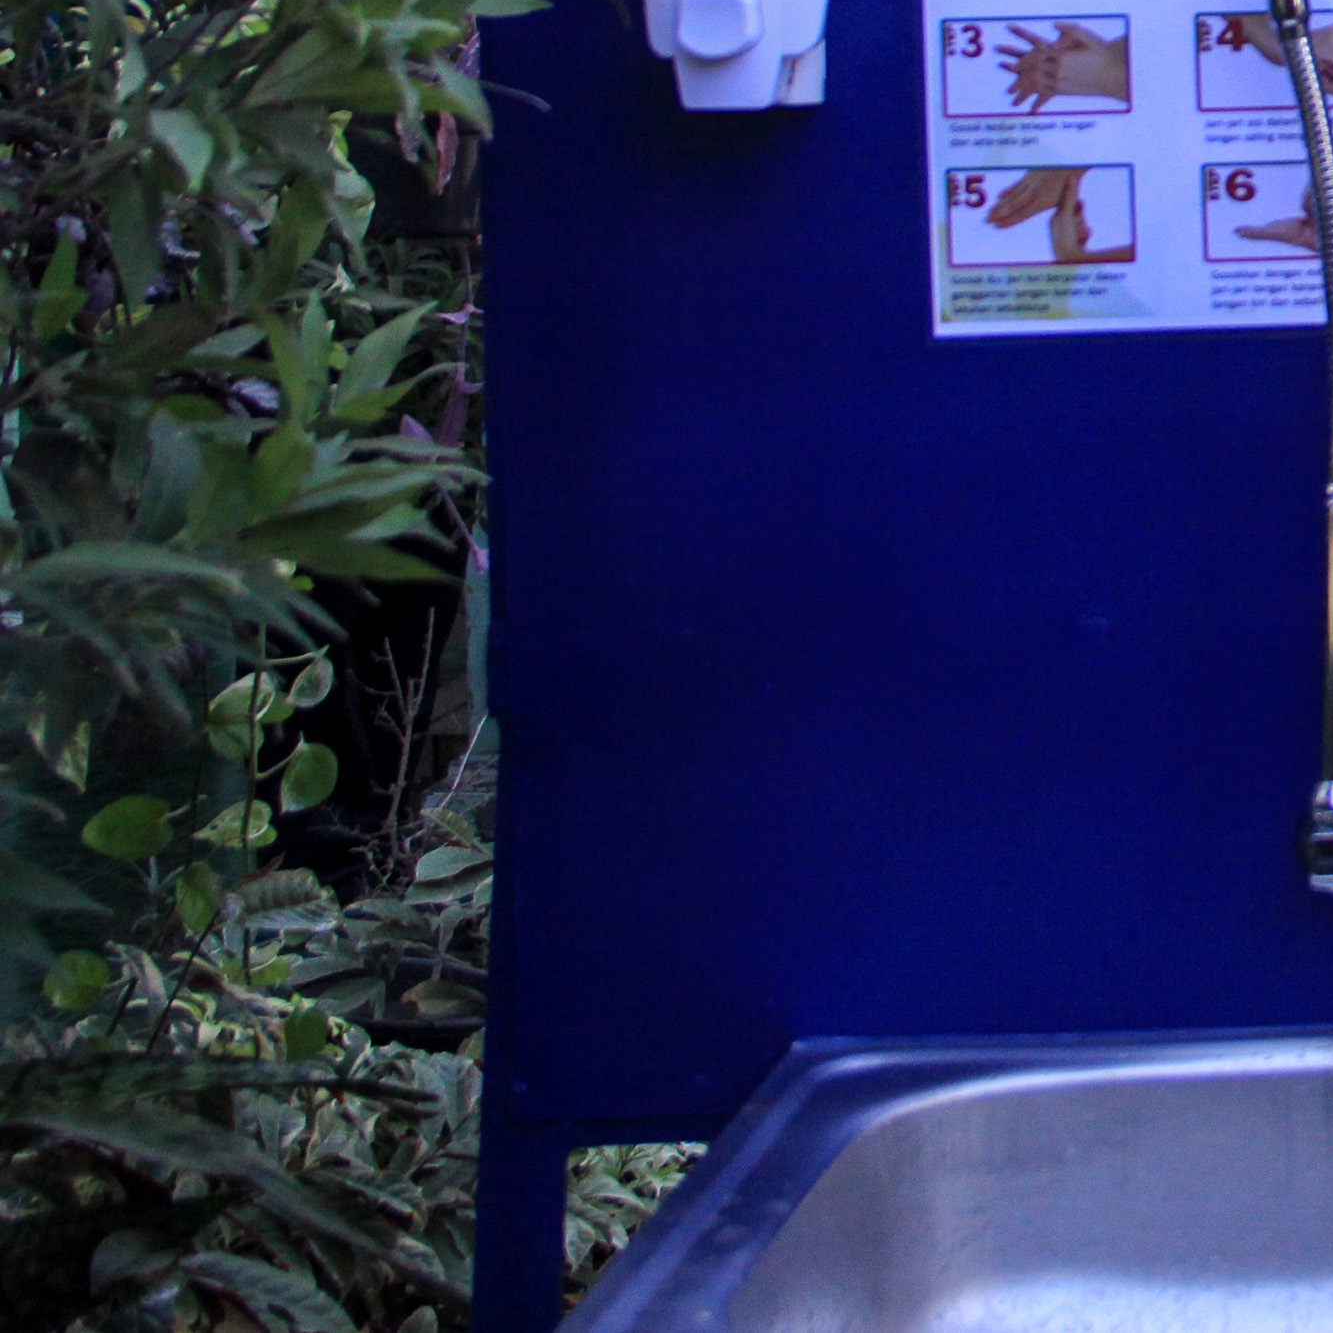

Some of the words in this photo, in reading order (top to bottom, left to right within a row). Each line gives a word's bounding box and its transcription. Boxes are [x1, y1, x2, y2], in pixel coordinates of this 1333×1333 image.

[960, 24, 984, 58] 3
[1217, 17, 1250, 52] 4
[965, 174, 988, 208] 5
[1225, 169, 1257, 202] 6
